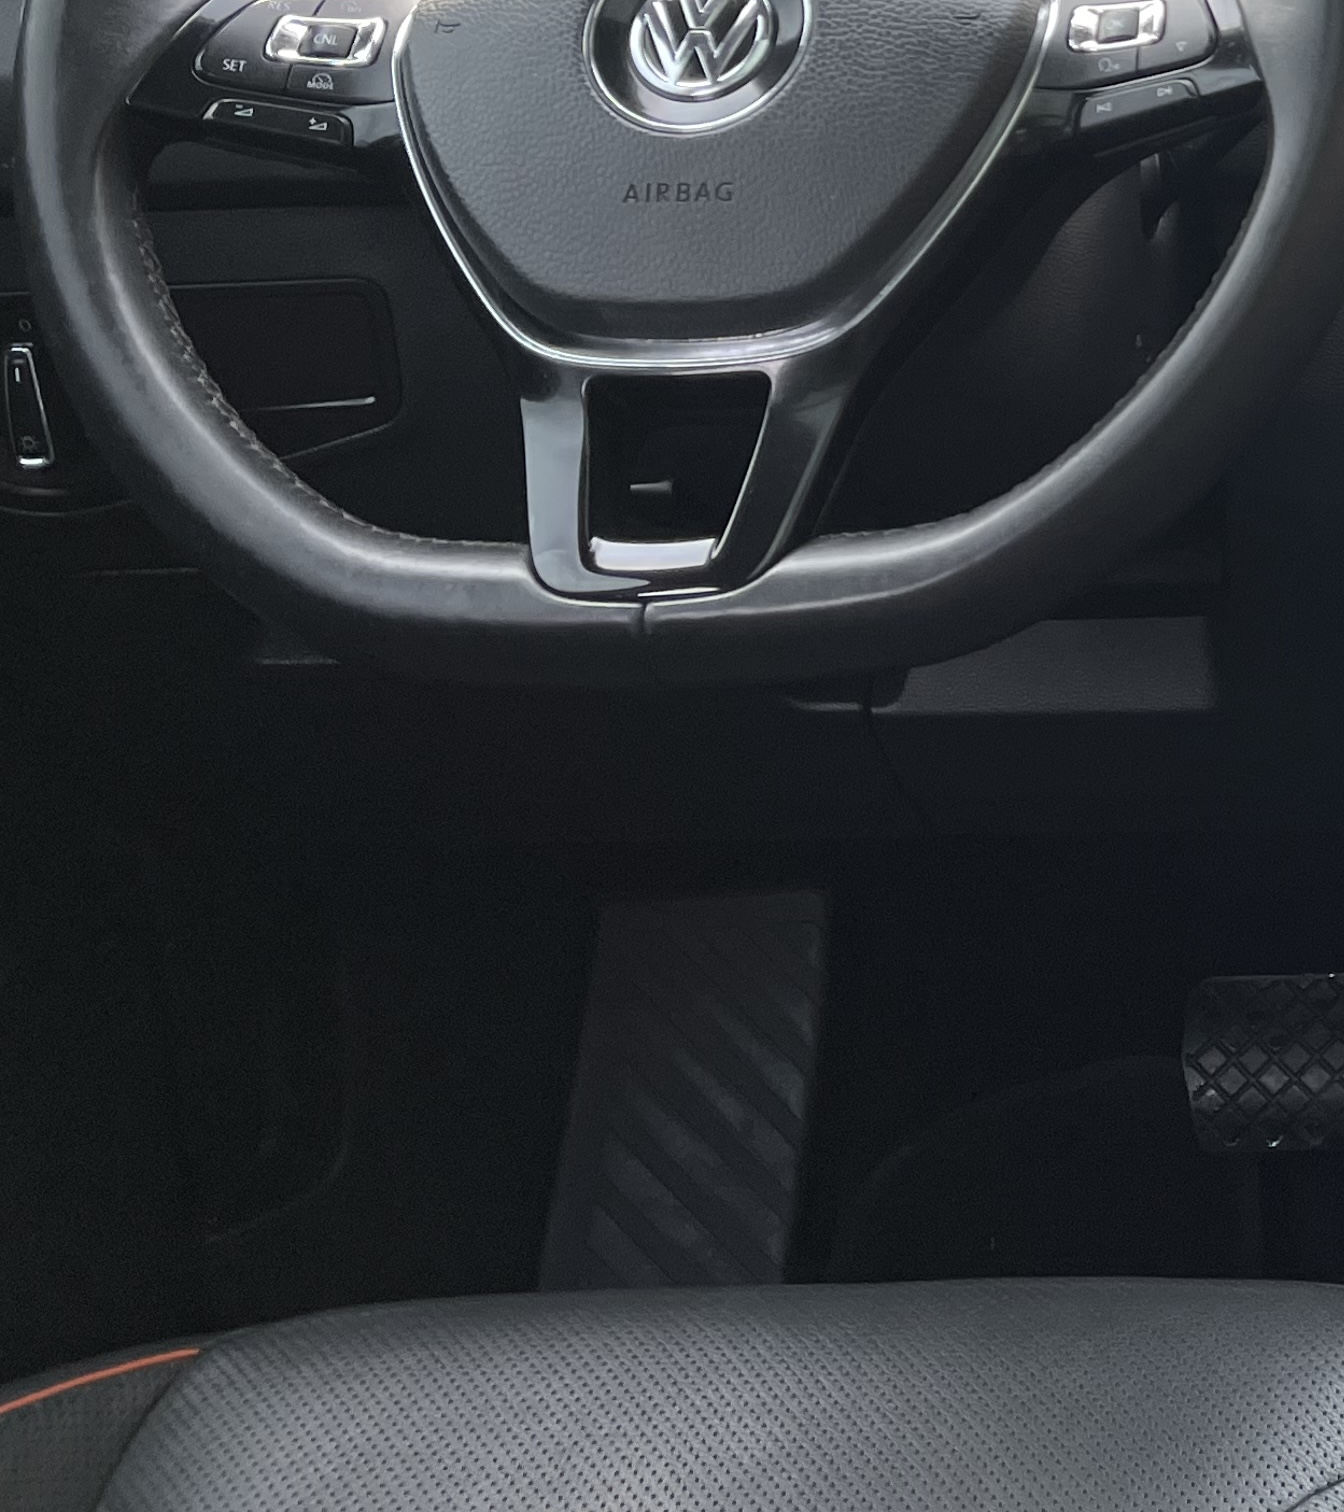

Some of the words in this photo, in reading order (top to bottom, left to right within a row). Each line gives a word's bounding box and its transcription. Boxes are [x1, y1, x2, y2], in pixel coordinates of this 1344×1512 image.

[313, 33, 338, 46] CNL
[222, 58, 247, 73] SET
[307, 80, 334, 90] MODE
[622, 181, 734, 203] AIRBAG
